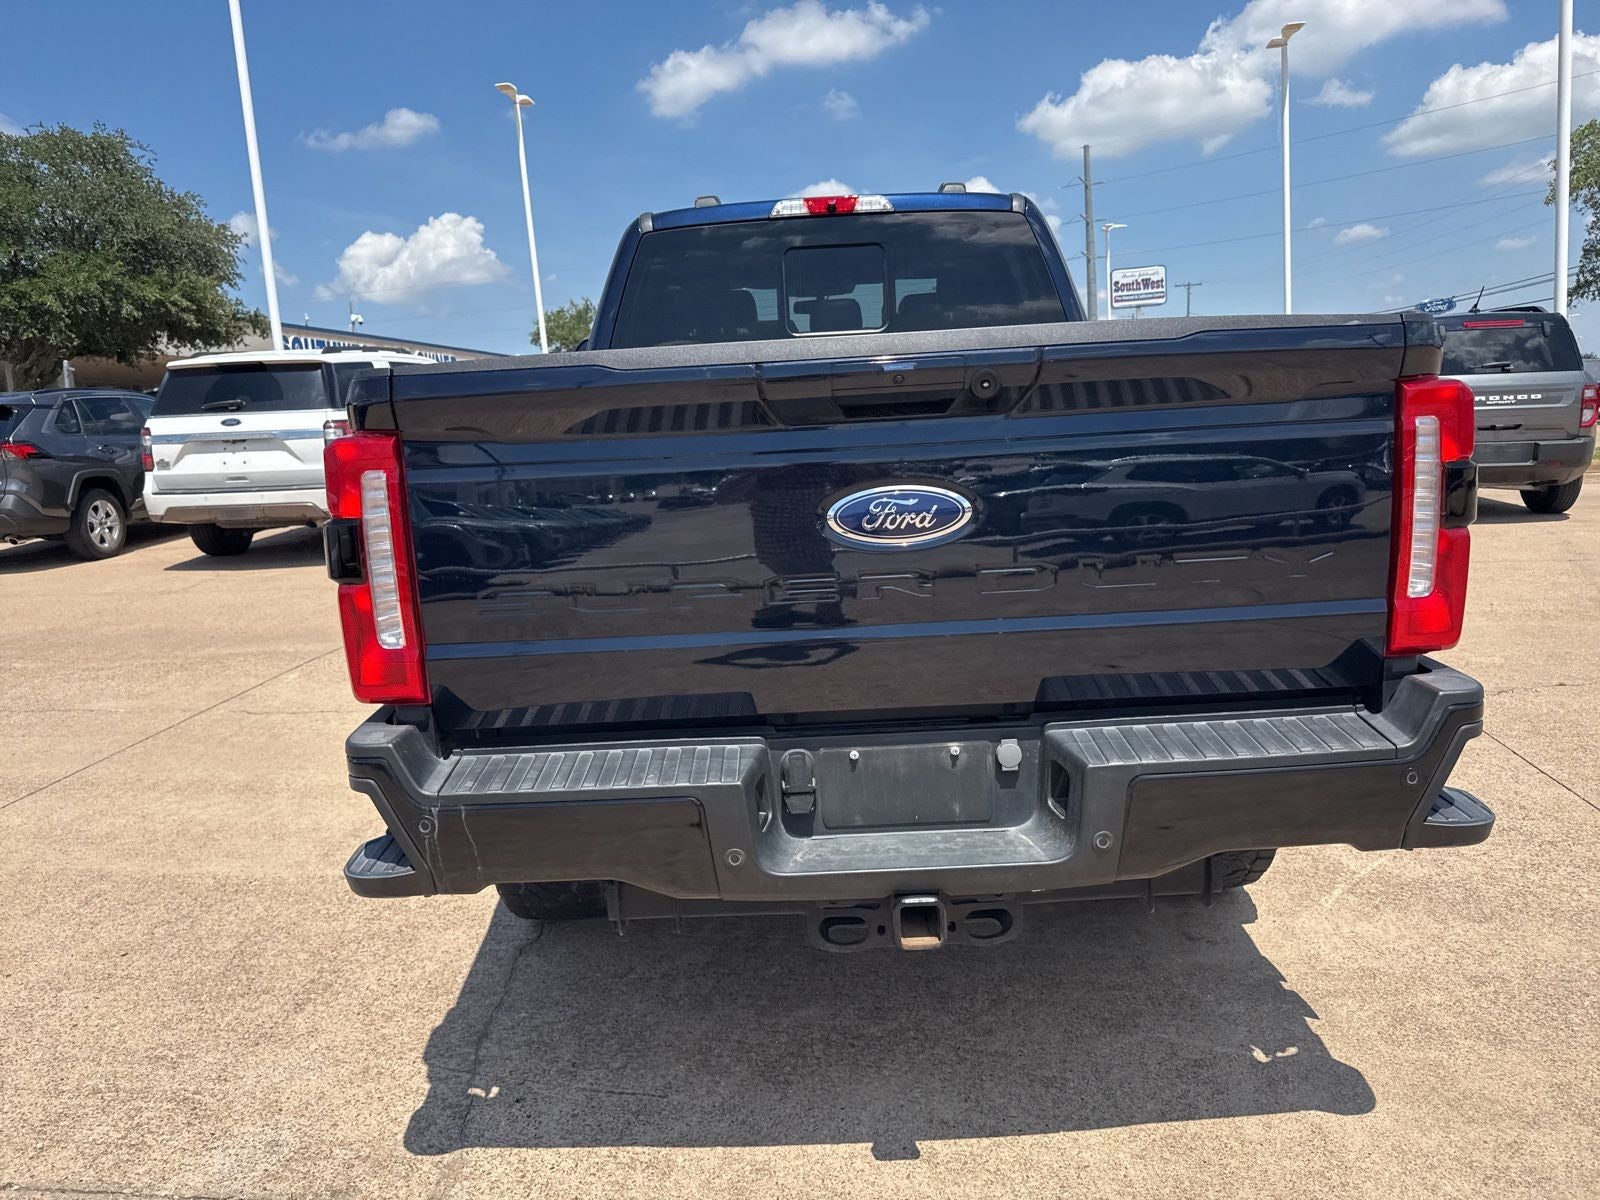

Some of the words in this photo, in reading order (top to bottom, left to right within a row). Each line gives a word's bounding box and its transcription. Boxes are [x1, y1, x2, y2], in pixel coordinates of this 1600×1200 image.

[1114, 278, 1164, 292] SouthWest
[1424, 301, 1449, 311] Ford
[1474, 393, 1542, 401] RONCO
[861, 498, 938, 531] Ford
